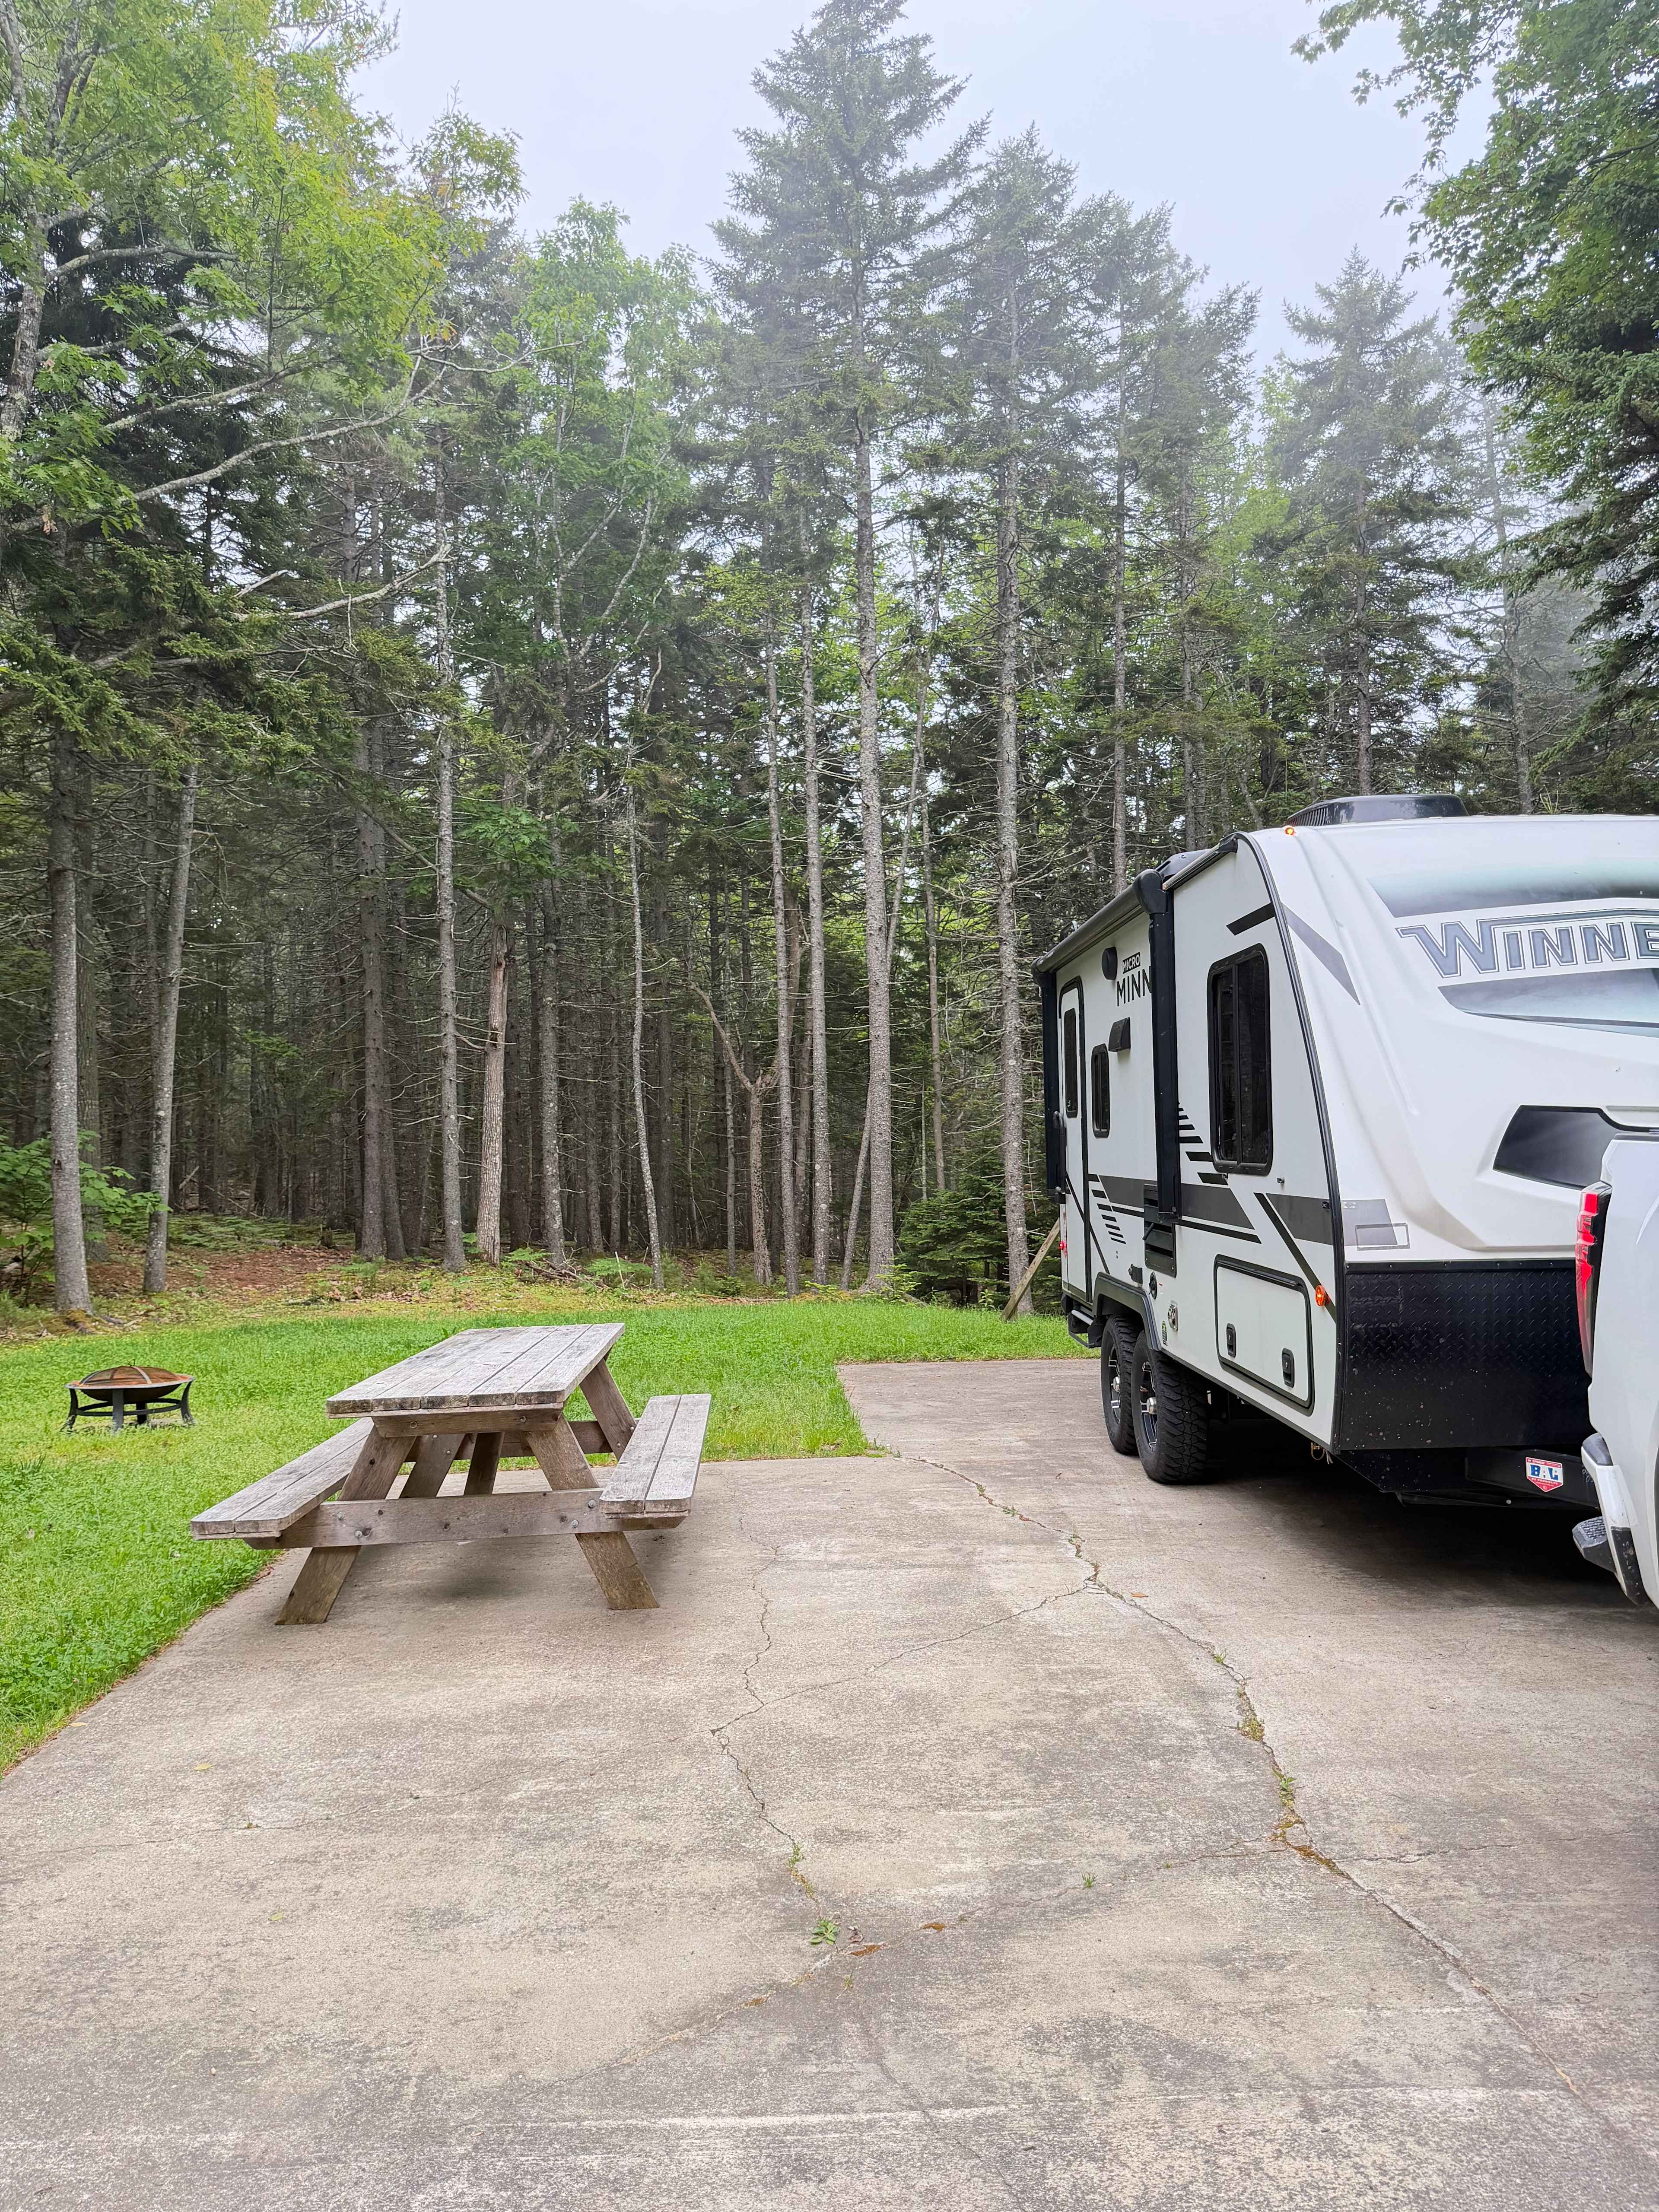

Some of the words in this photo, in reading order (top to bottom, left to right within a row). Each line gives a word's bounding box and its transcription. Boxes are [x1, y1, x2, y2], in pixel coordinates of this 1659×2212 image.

[1395, 908, 1659, 978] WINNE
[1123, 954, 1140, 971] MICRO
[1117, 966, 1152, 1007] MINN
[1530, 1464, 1559, 1481] BAL
